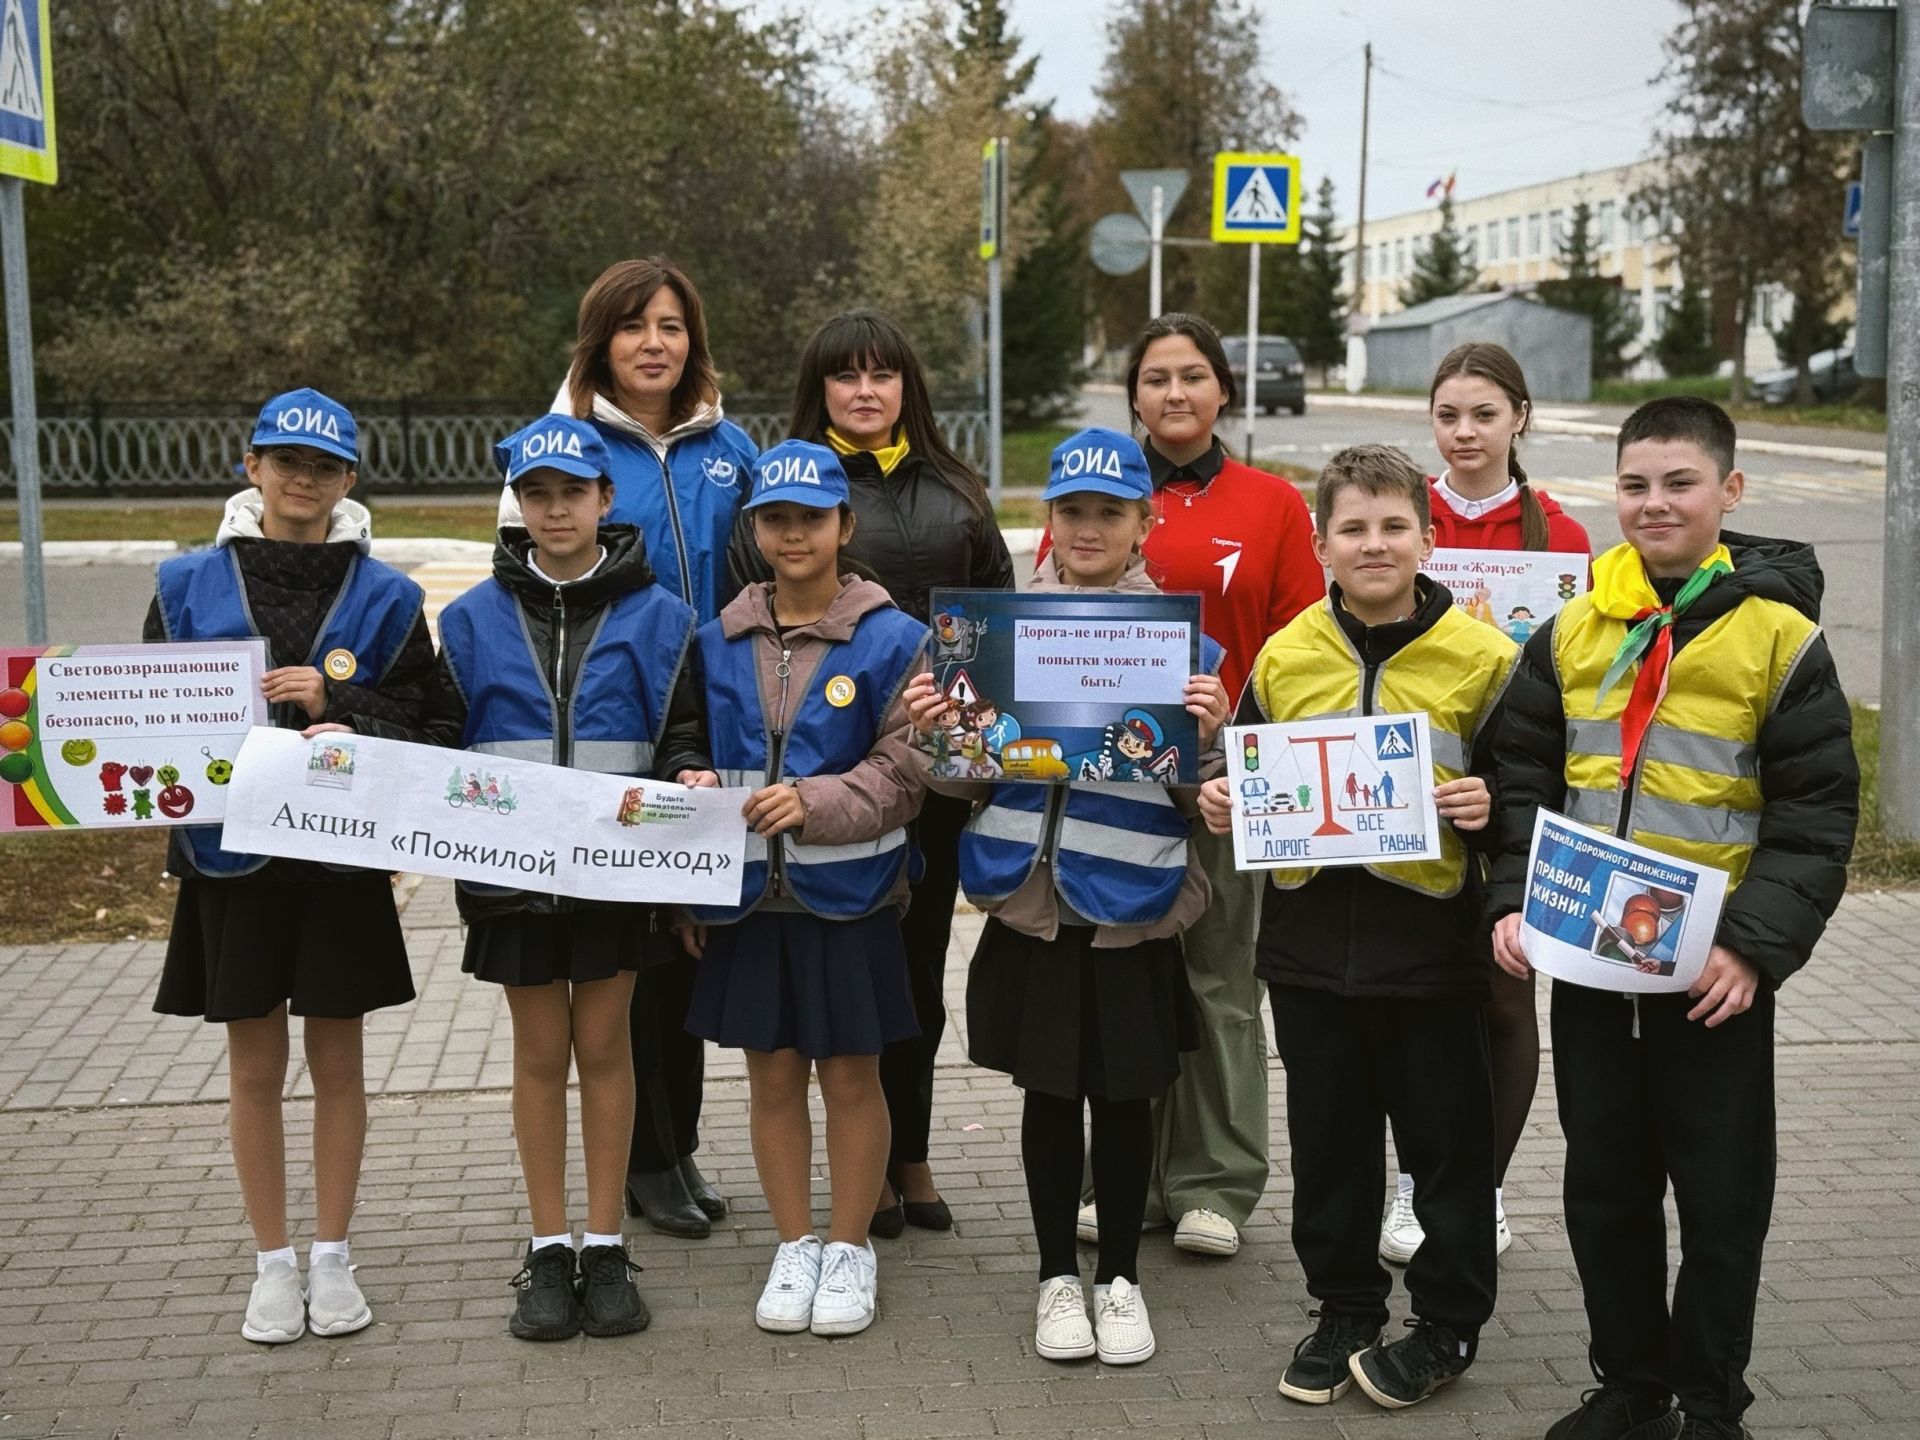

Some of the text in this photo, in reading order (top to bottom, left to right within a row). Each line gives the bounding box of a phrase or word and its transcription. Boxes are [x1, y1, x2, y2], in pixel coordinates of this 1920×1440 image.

[277, 408, 340, 442] ЮИД
[522, 430, 583, 464] ЮИД
[1061, 447, 1122, 479] ЮИД
[761, 457, 820, 490] ЮИД
[1093, 625, 1133, 640] игра!
[1135, 626, 1186, 640] Второй
[48, 660, 240, 678] Световозвращающие
[1037, 654, 1167, 667] попытки может не
[1080, 674, 1122, 688] быть!
[56, 686, 234, 702] элементы не только
[45, 705, 247, 728] безопасно, но и модно!
[641, 802, 697, 811] внимательны
[656, 793, 684, 802] Будьте
[1248, 819, 1272, 836] НА
[1356, 813, 1385, 831] ВСЕ
[271, 802, 731, 876] Акция «Пожилой пешеход»
[1262, 838, 1311, 858] ДОРОГЕ
[1380, 834, 1426, 852] РАВНЫ
[1542, 826, 1575, 849] ПРАВИЛА
[1574, 841, 1629, 867] ДОРОЖНОГО
[1629, 860, 1688, 886] ДВИЖЕНИЯ
[1535, 860, 1592, 896] ПРАВИЛА
[1531, 882, 1588, 919] ЖИЗНИ!
